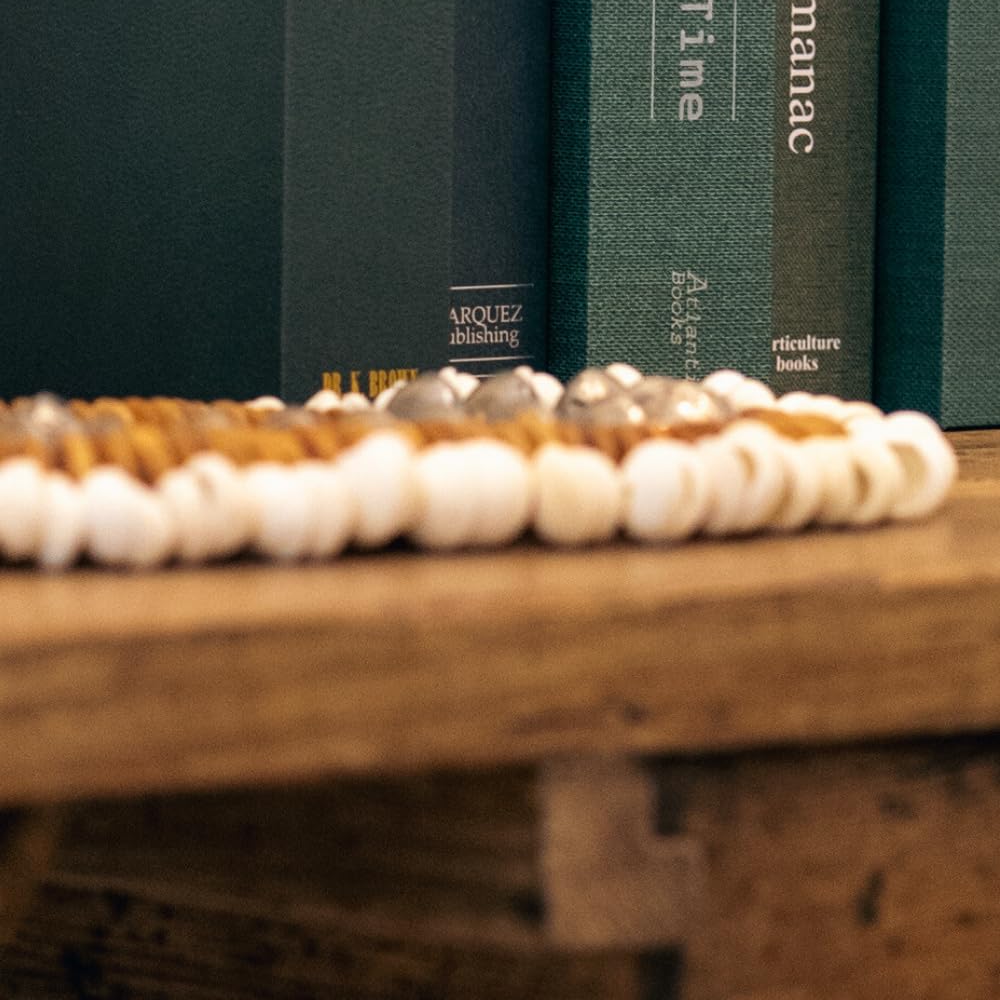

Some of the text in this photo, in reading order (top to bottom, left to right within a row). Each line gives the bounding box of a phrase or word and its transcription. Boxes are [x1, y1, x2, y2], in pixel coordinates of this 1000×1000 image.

[671, 270, 686, 345] Books
[771, 333, 841, 351] rticulture
[776, 354, 819, 372] books
